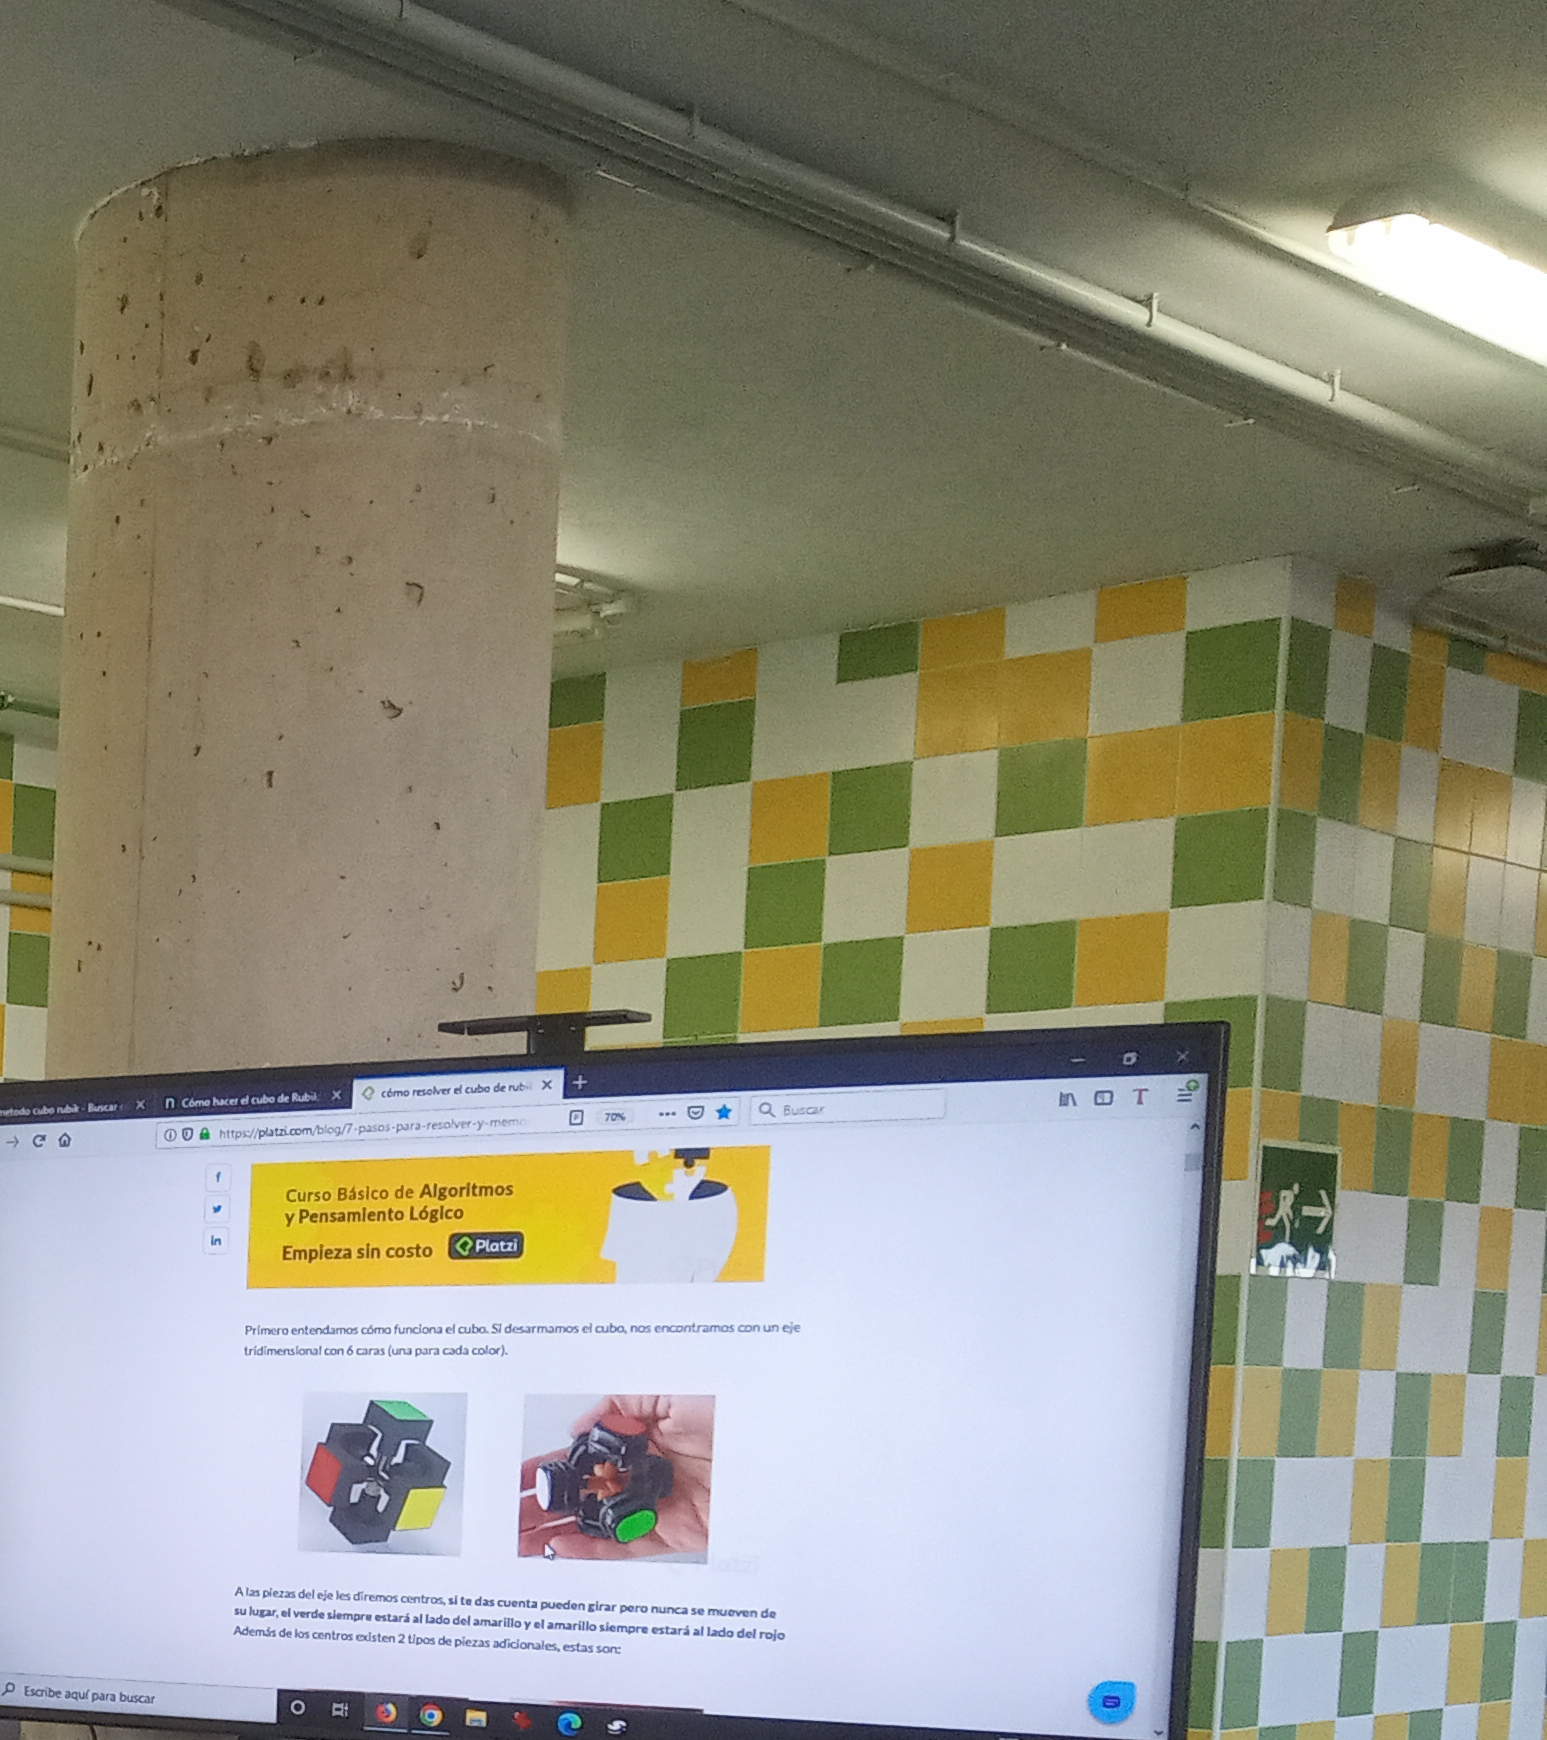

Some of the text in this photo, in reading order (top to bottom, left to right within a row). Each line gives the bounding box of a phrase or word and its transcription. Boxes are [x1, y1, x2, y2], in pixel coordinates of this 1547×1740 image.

[380, 1086, 410, 1098] cómo
[412, 1085, 451, 1097] resolver
[453, 1084, 463, 1094] el
[465, 1083, 490, 1094] cubo
[493, 1082, 507, 1093] de
[32, 1105, 55, 1116] cubo
[88, 1102, 117, 1113] Buscar
[181, 1096, 210, 1109] Cómo
[212, 1095, 238, 1107] hacer
[240, 1095, 249, 1105] el
[251, 1094, 275, 1105] cubo
[277, 1092, 290, 1103] de
[604, 1111, 626, 1122] 70%
[783, 1104, 826, 1117] Buscar
[286, 1181, 514, 1203] Curso Básico de Algoritmos
[284, 1204, 464, 1227] y Pensamiento Lógico
[282, 1243, 434, 1264] Empieza sin costo
[474, 1238, 518, 1254] Platzi
[245, 1321, 801, 1337] Primero entendamos cómo funciona el cubo. Si desarmamos el cubo, nos encontramos con un eje
[244, 1344, 508, 1358] tridimensional con 6 caras (una para cada color).
[234, 1586, 777, 1619] A las piezas del eje les diremos centros, si te das cuenta pueden girar pero nunca se mueven de
[234, 1605, 786, 1642] su lugar, el verde siempre estará al lado del amarillo y el amarillo siempre estará al lado del rojo
[233, 1625, 277, 1638] Además
[279, 1628, 292, 1639] de
[294, 1628, 309, 1640] los
[312, 1630, 353, 1642] centros
[355, 1631, 396, 1644] existen
[397, 1633, 406, 1644] 2
[408, 1634, 436, 1647] tipos
[437, 1635, 452, 1647] de
[454, 1636, 490, 1649] piezas
[492, 1638, 561, 1652] adicionales,
[562, 1642, 594, 1654] estas
[24, 1685, 156, 1704] Escribe aquí para buscar
